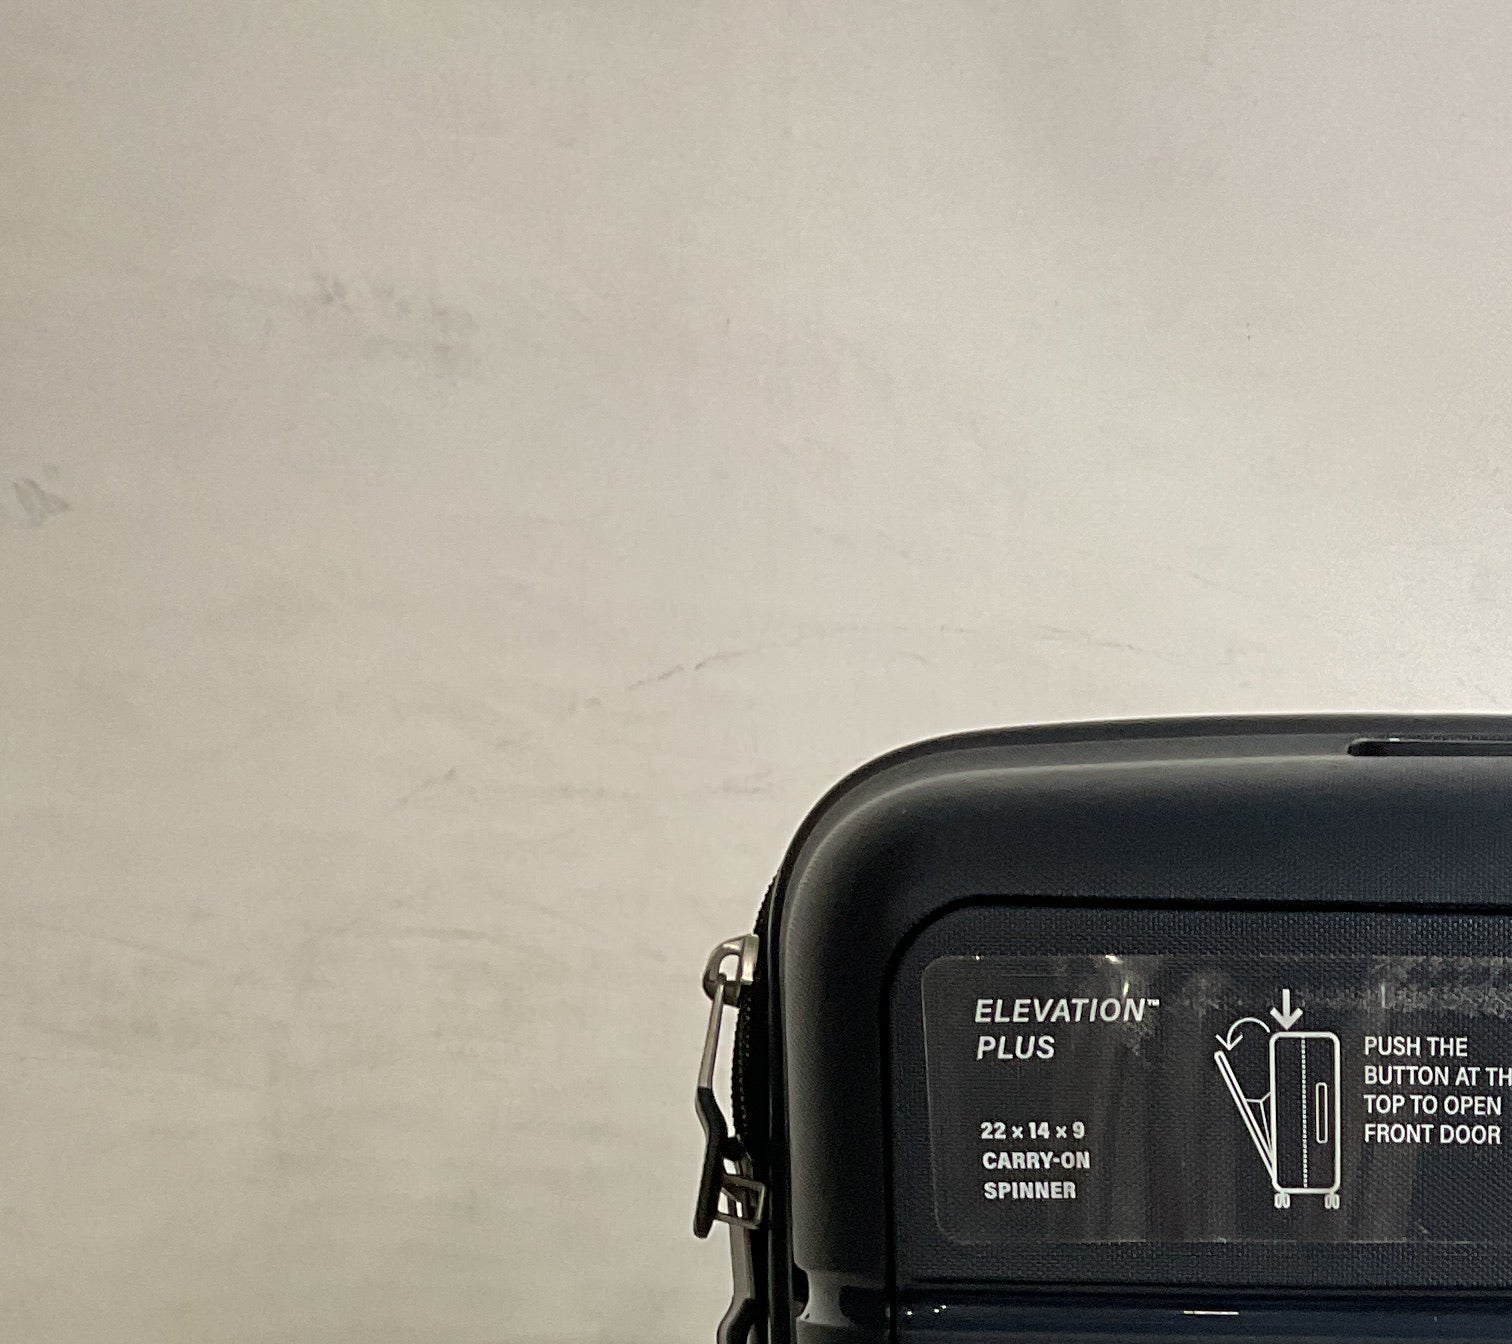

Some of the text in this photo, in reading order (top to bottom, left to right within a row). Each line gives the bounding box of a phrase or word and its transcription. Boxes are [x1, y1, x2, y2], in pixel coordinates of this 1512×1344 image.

[977, 1035, 1056, 1061] PLUS
[1364, 1036, 1468, 1057] PUSH THE
[1364, 1065, 1449, 1086] BUTTON
[1455, 1067, 1481, 1086] AT
[1363, 1094, 1502, 1116] TOP TO OPEN
[980, 1121, 1007, 1140] 22
[1028, 1121, 1050, 1139] 14
[1072, 1121, 1085, 1139] 9
[1364, 1123, 1502, 1145] FRONT DOOR
[982, 1151, 1091, 1169] CARRY-ON
[983, 1181, 1076, 1199] SPINNER
